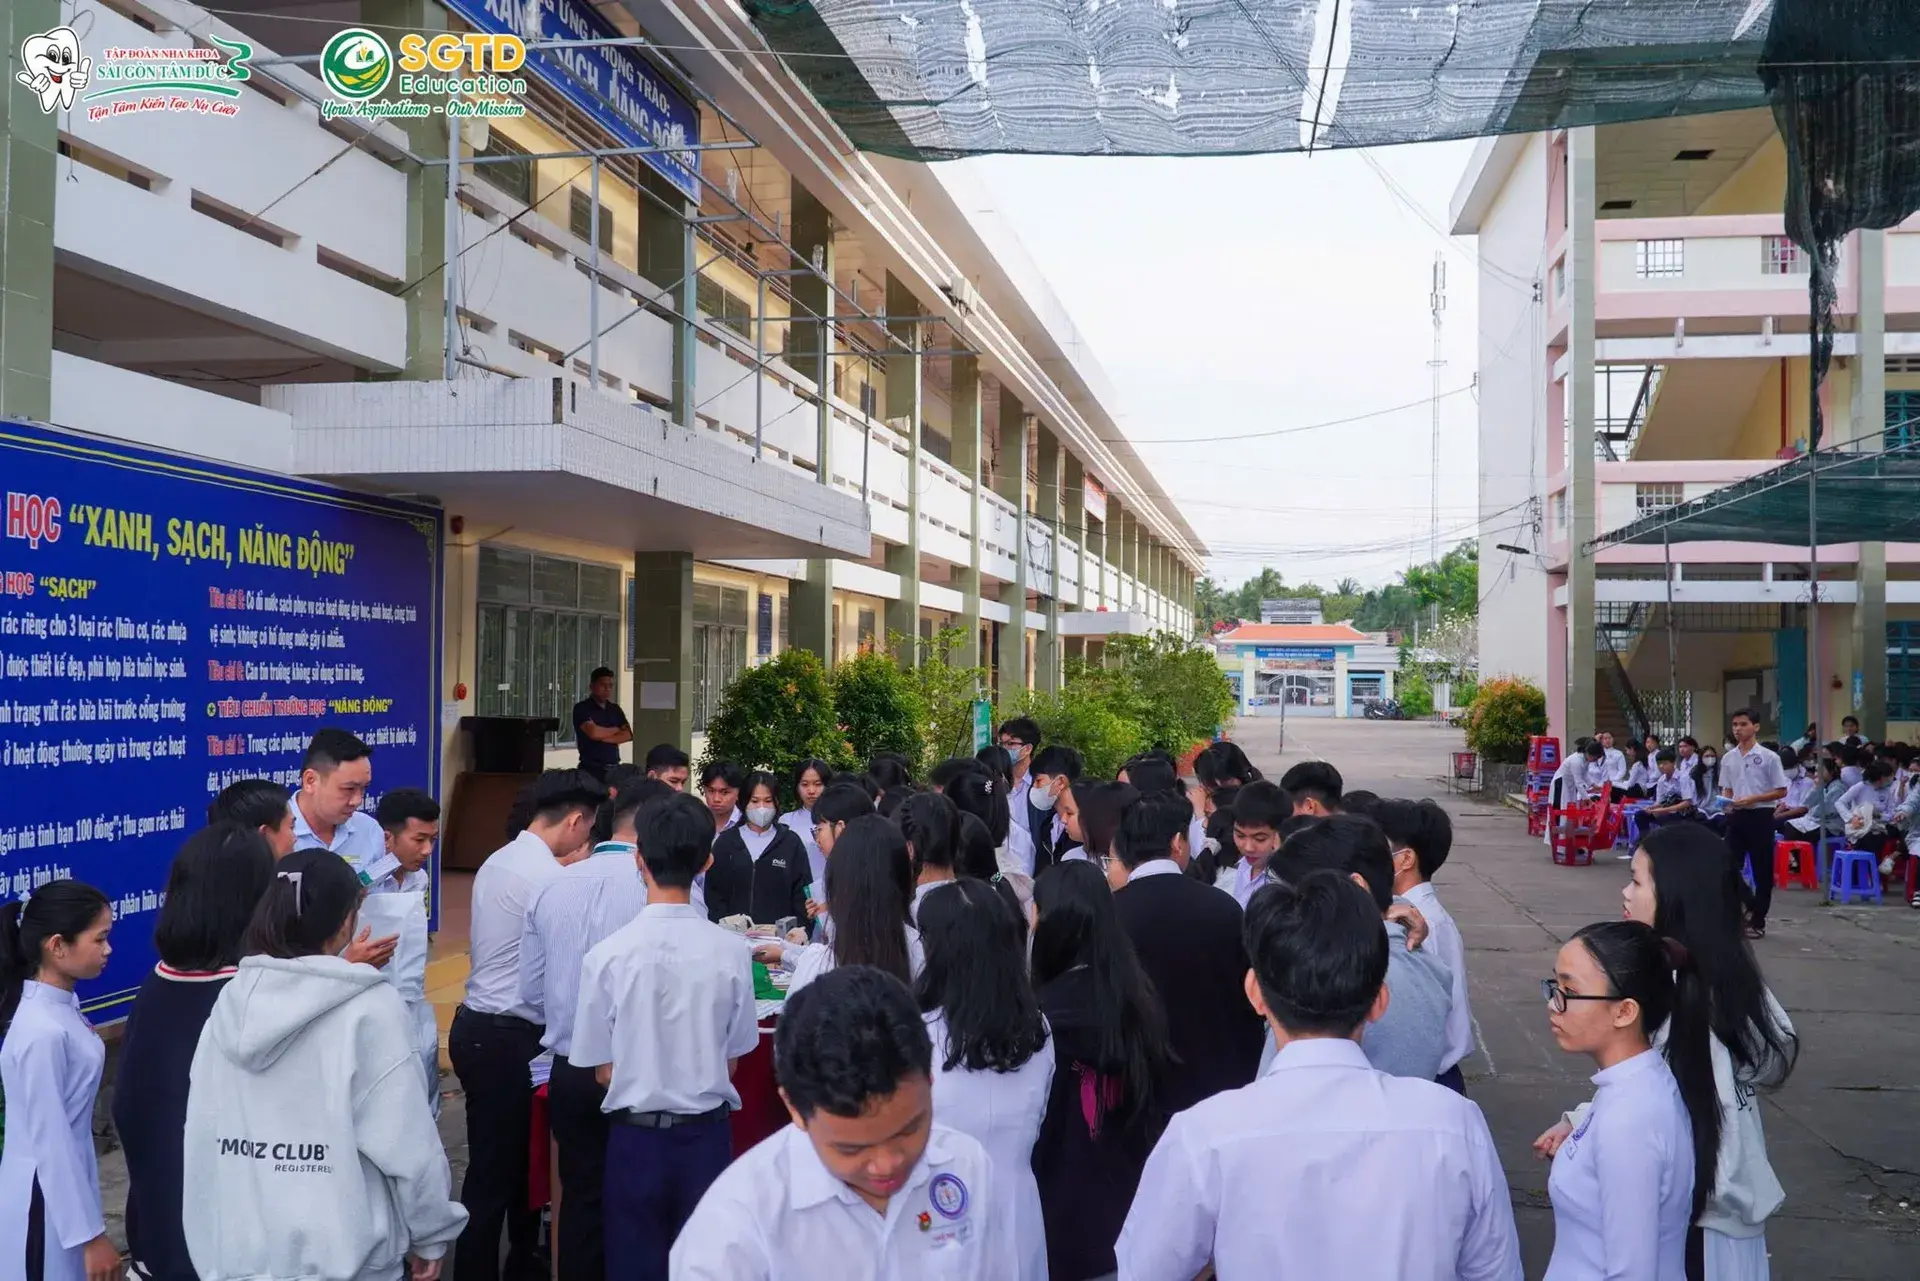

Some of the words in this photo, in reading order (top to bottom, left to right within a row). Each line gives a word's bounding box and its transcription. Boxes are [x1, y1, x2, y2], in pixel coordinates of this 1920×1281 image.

[637, 70, 671, 118] TRÀO:
[7, 491, 61, 549] HỌC
[69, 504, 159, 561] “XANH,
[167, 517, 232, 570] SẠCH,
[239, 522, 292, 569] NĂNG
[297, 530, 355, 579] ĐỘNG”
[5, 571, 34, 599] HỌC
[246, 590, 255, 610] Có
[1, 611, 19, 634] rác
[21, 612, 47, 639] riêng
[50, 613, 67, 637] cho
[69, 614, 76, 637] 3
[78, 615, 95, 642] loại
[97, 616, 113, 639] rác
[115, 617, 135, 641] (hữu
[136, 621, 150, 644] cơ,
[151, 619, 166, 640] rác
[167, 620, 187, 645] nhựa
[209, 623, 218, 648] vệ
[237, 624, 258, 648] không
[259, 626, 268, 645] có
[294, 628, 309, 647] nước
[309, 629, 321, 651] gây
[7, 653, 29, 682] được
[31, 651, 52, 677] thiết
[54, 652, 67, 677] kế
[67, 654, 86, 682] đẹp,
[88, 654, 104, 682] phù
[106, 656, 121, 682] hợp
[123, 656, 135, 678] lứa
[137, 652, 152, 678] tuổi
[154, 657, 169, 682] học
[169, 657, 187, 678] sinh.
[269, 661, 291, 685] trường
[291, 661, 311, 685] không
[14, 700, 41, 728] trạng
[43, 699, 59, 722] vứt
[61, 698, 77, 721] rác
[79, 698, 96, 721] bừa
[98, 698, 113, 720] bãi
[114, 698, 138, 720] trước
[139, 693, 159, 722] cổng
[161, 697, 187, 722] trường
[218, 695, 240, 718] TIÊU
[241, 691, 273, 717] CHUẨN
[274, 695, 308, 717] TRƯỜNG
[308, 698, 326, 718] HỌC
[328, 696, 361, 714] “NĂNG
[362, 695, 393, 716] ĐỘNG”
[3, 740, 11, 766] ở
[13, 741, 35, 769] hoạt
[37, 740, 60, 769] động
[62, 738, 93, 764] thường
[94, 738, 116, 763] ngày
[117, 737, 127, 759] và
[129, 737, 151, 761] trong
[153, 735, 167, 756] các
[168, 734, 187, 760] hoạt
[207, 734, 224, 757] Tiêu
[247, 733, 268, 756] Trong
[268, 732, 281, 752] các
[281, 731, 301, 755] phòng
[365, 728, 376, 746] các
[18, 825, 35, 849] nhà
[38, 823, 55, 848] tình
[57, 822, 74, 848] bạn
[76, 818, 92, 842] 100
[123, 814, 136, 836] thu
[138, 816, 154, 838] gom
[156, 810, 169, 832] rác
[170, 805, 186, 830] thải
[13, 866, 30, 893] nhà
[120, 892, 140, 919] phân
[142, 889, 157, 911] hữu
